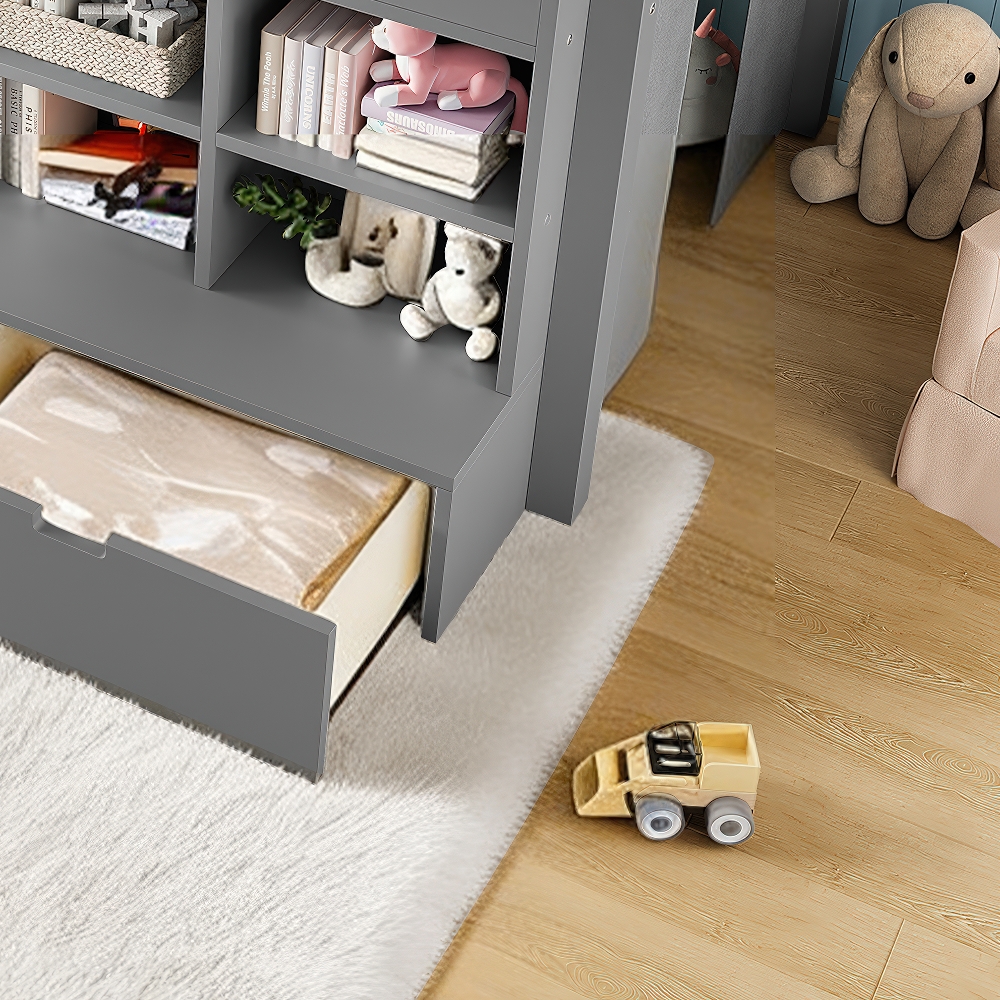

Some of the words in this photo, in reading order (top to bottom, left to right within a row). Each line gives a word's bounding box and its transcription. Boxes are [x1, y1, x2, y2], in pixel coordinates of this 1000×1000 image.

[263, 51, 272, 71] Pooh
[10, 88, 18, 117] BASIC
[302, 65, 316, 130] UNICORNS
